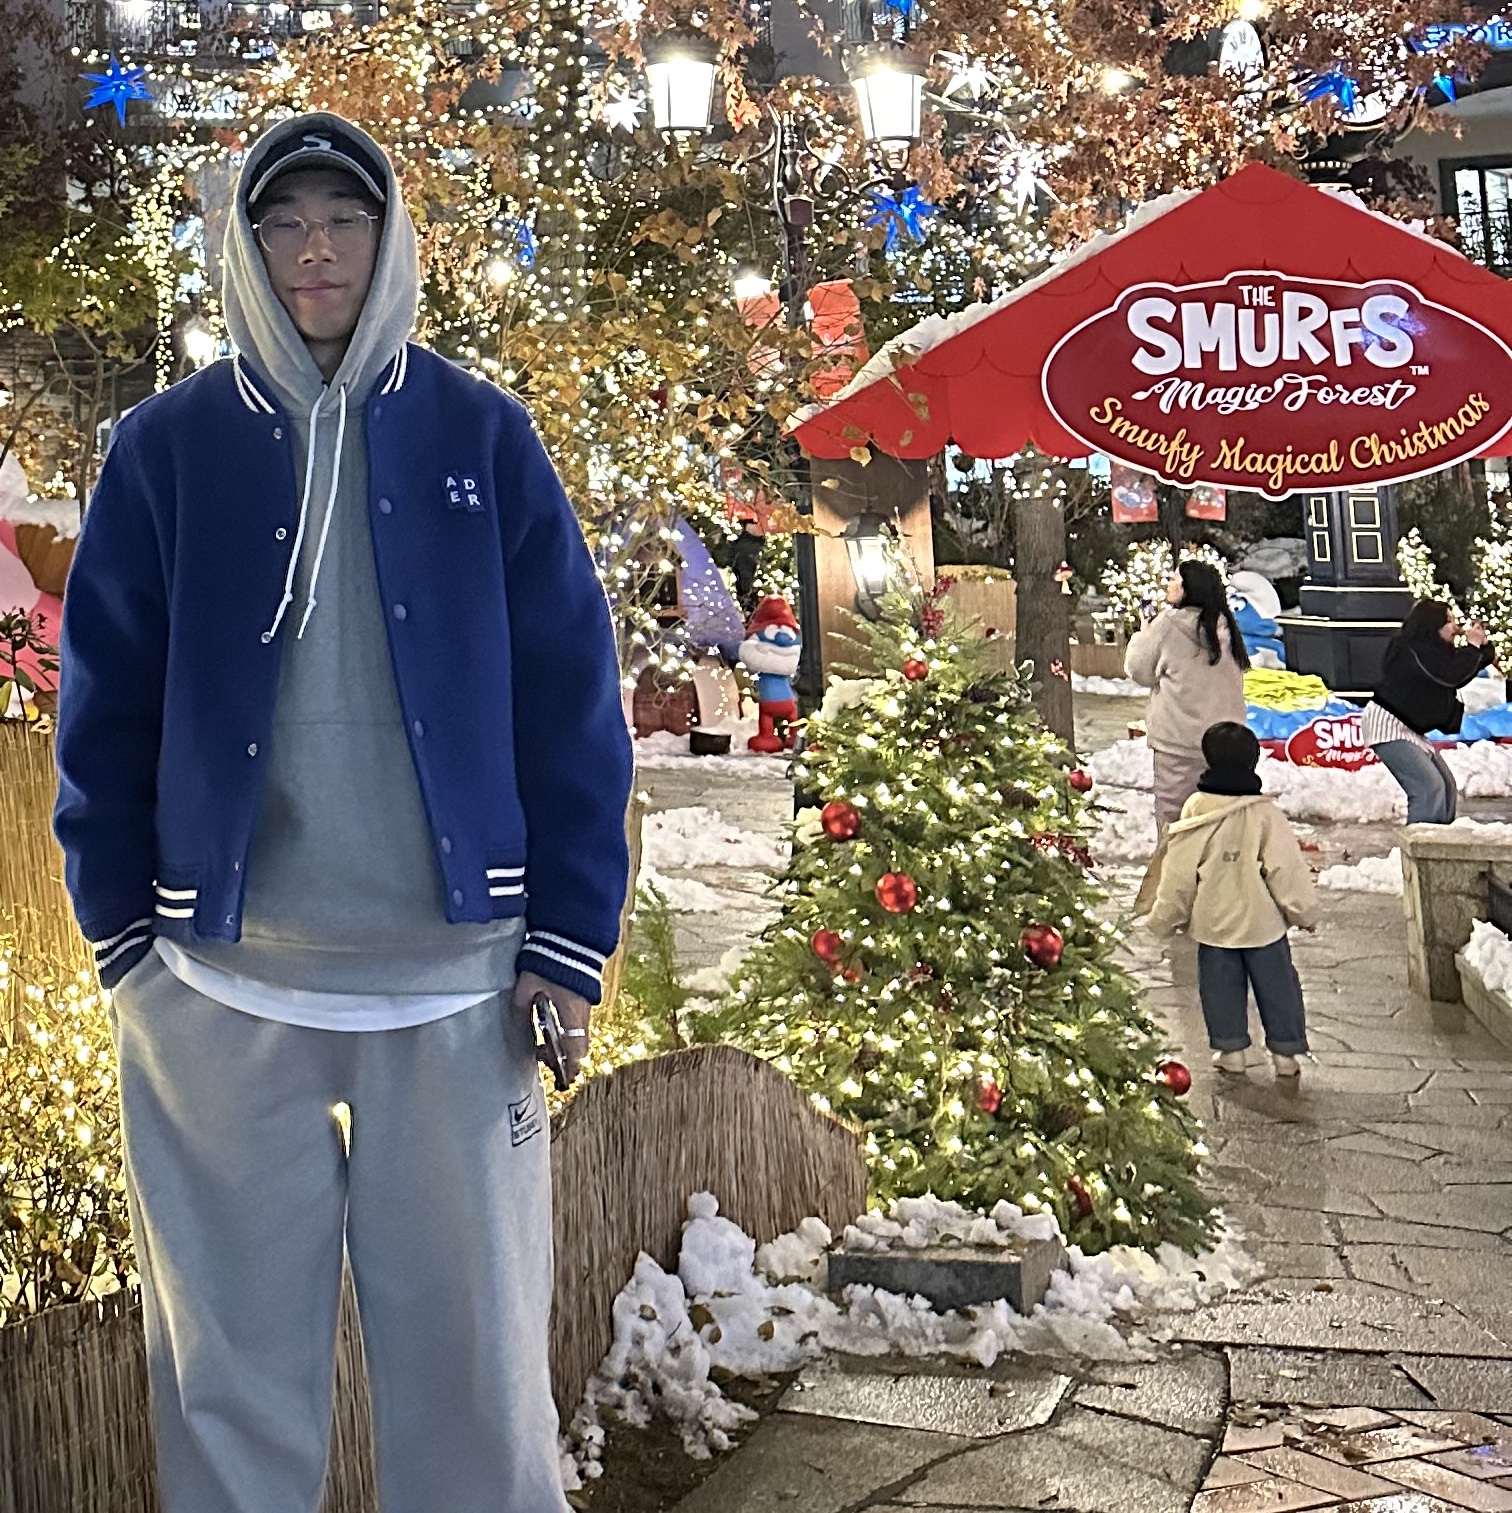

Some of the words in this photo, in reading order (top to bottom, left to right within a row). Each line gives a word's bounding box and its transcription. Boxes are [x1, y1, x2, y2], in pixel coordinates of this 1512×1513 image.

[1239, 286, 1276, 307] THE
[1127, 290, 1414, 376] SMURFS
[1132, 377, 1284, 415] Magic
[1282, 373, 1417, 412] Forest
[1089, 397, 1204, 478] Smurfy
[1210, 437, 1345, 490] Magical
[1349, 392, 1491, 469] Christmas
[1313, 720, 1365, 750] SMU
